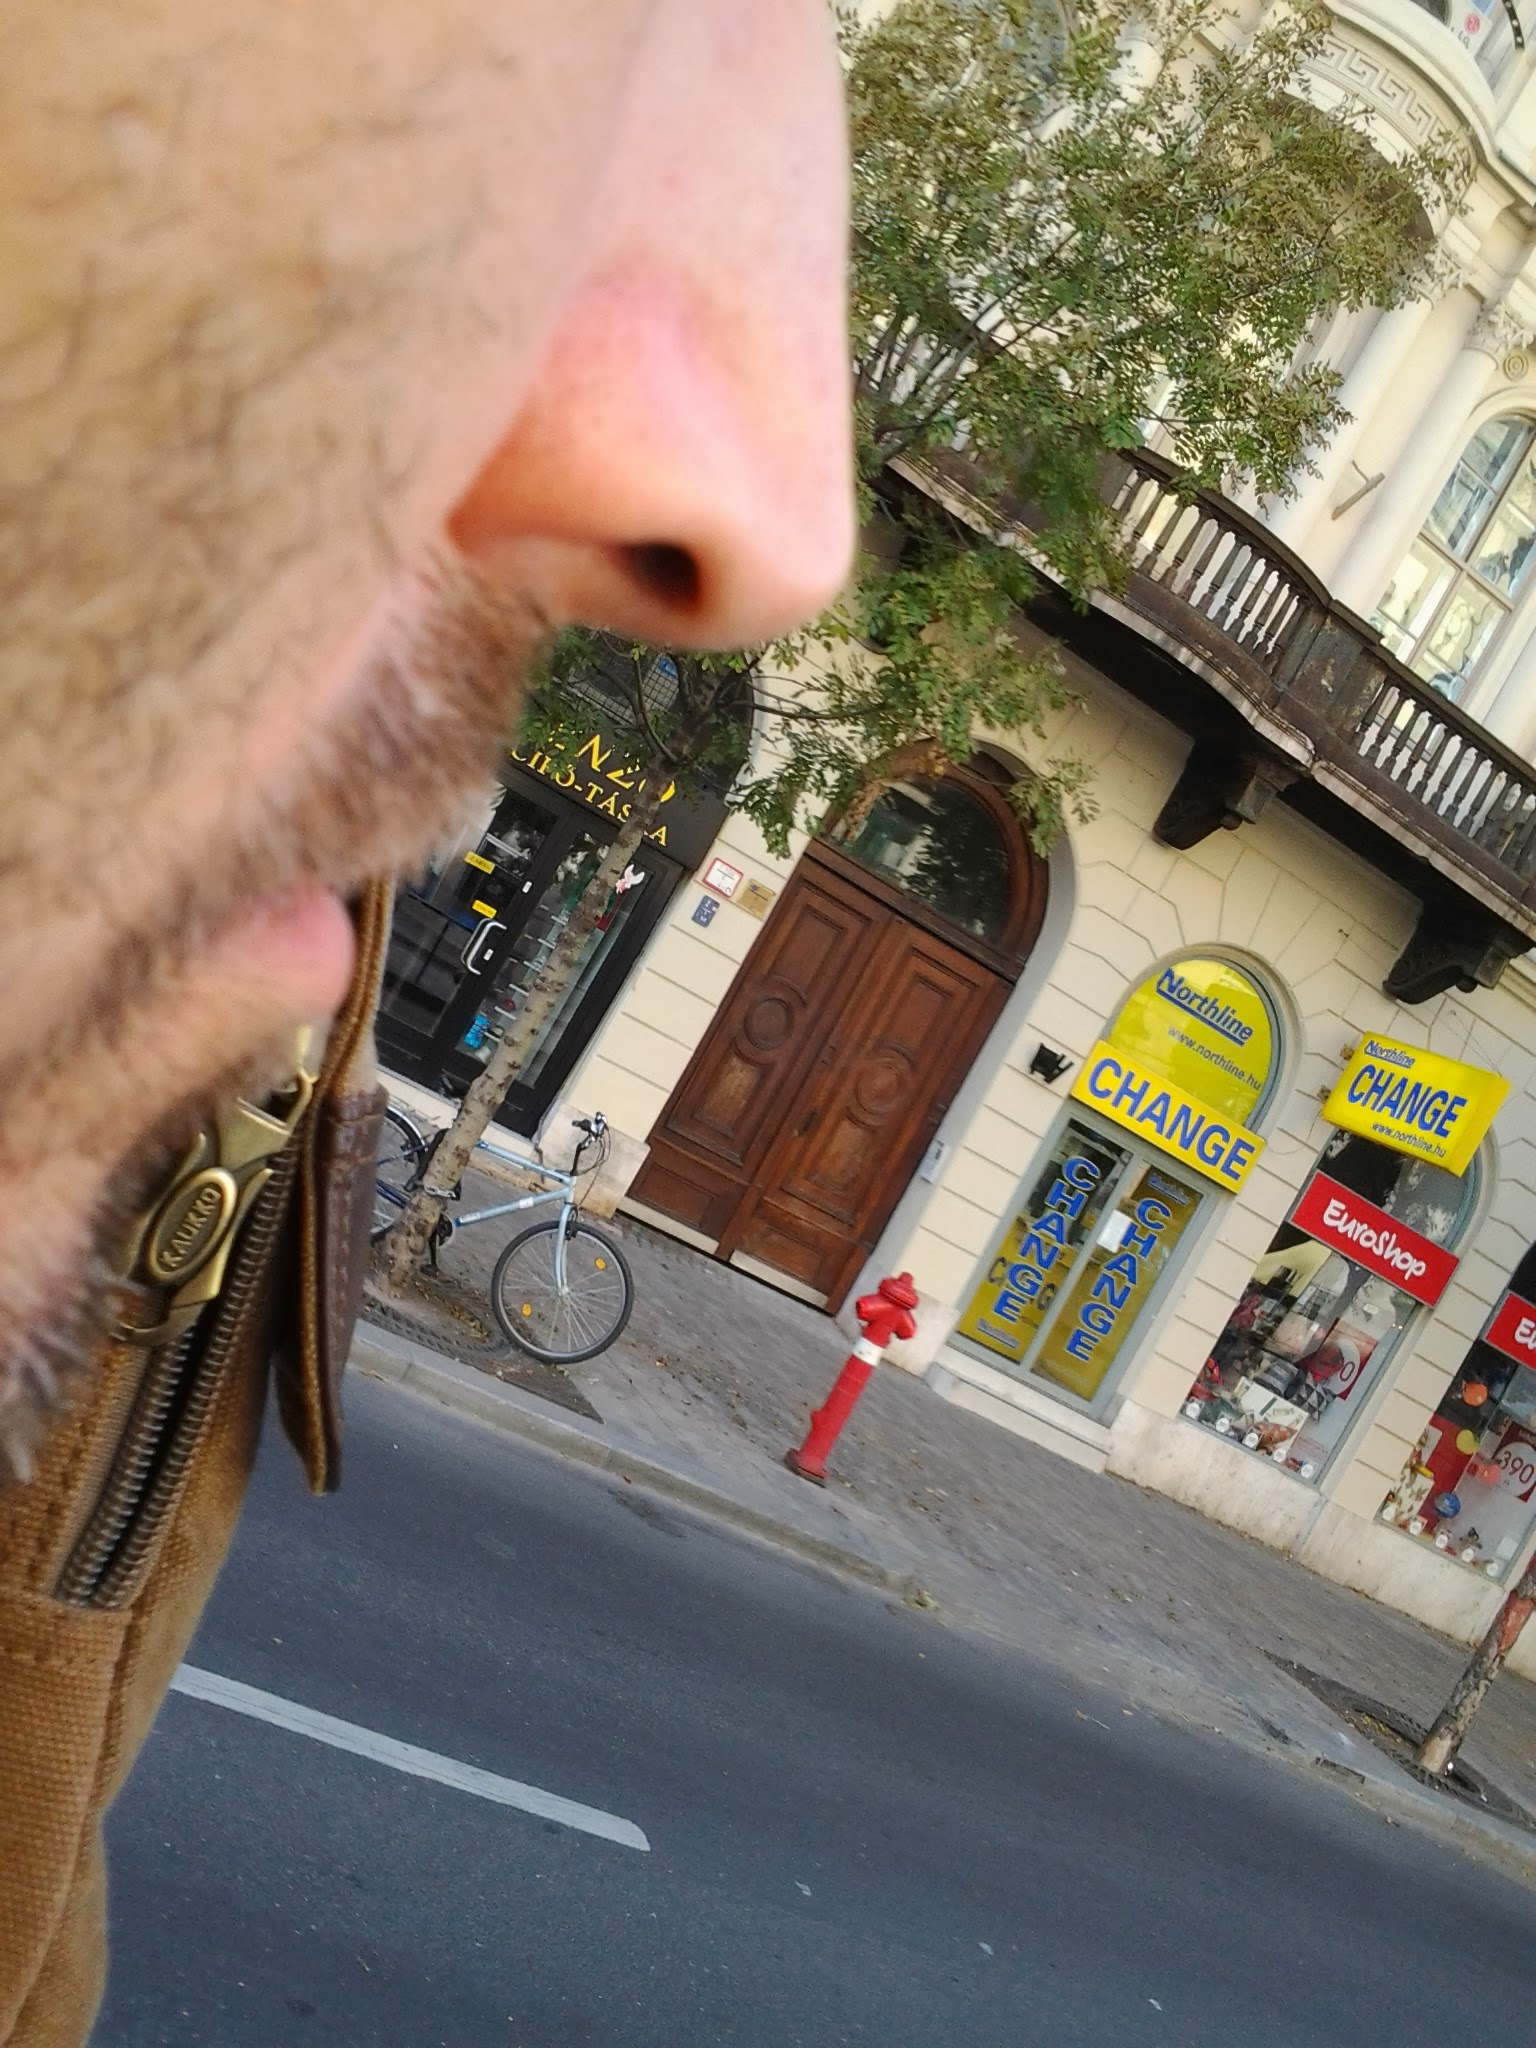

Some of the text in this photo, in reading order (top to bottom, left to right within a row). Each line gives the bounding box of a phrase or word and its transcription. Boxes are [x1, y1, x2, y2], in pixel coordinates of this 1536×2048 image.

[1156, 968, 1253, 1047] Northline
[1168, 1026, 1262, 1092] www.northline.hu
[1088, 1058, 1256, 1181] CHANGE
[1347, 1064, 1468, 1139] CHANGE
[1372, 1122, 1447, 1158] www.northline.hu
[160, 1187, 221, 1269] KAUKKO
[992, 1156, 1101, 1324] CHANGE
[1323, 1198, 1427, 1281] EuroShop
[1066, 1198, 1171, 1363] CHANGE
[1500, 1450, 1535, 1484] 390
